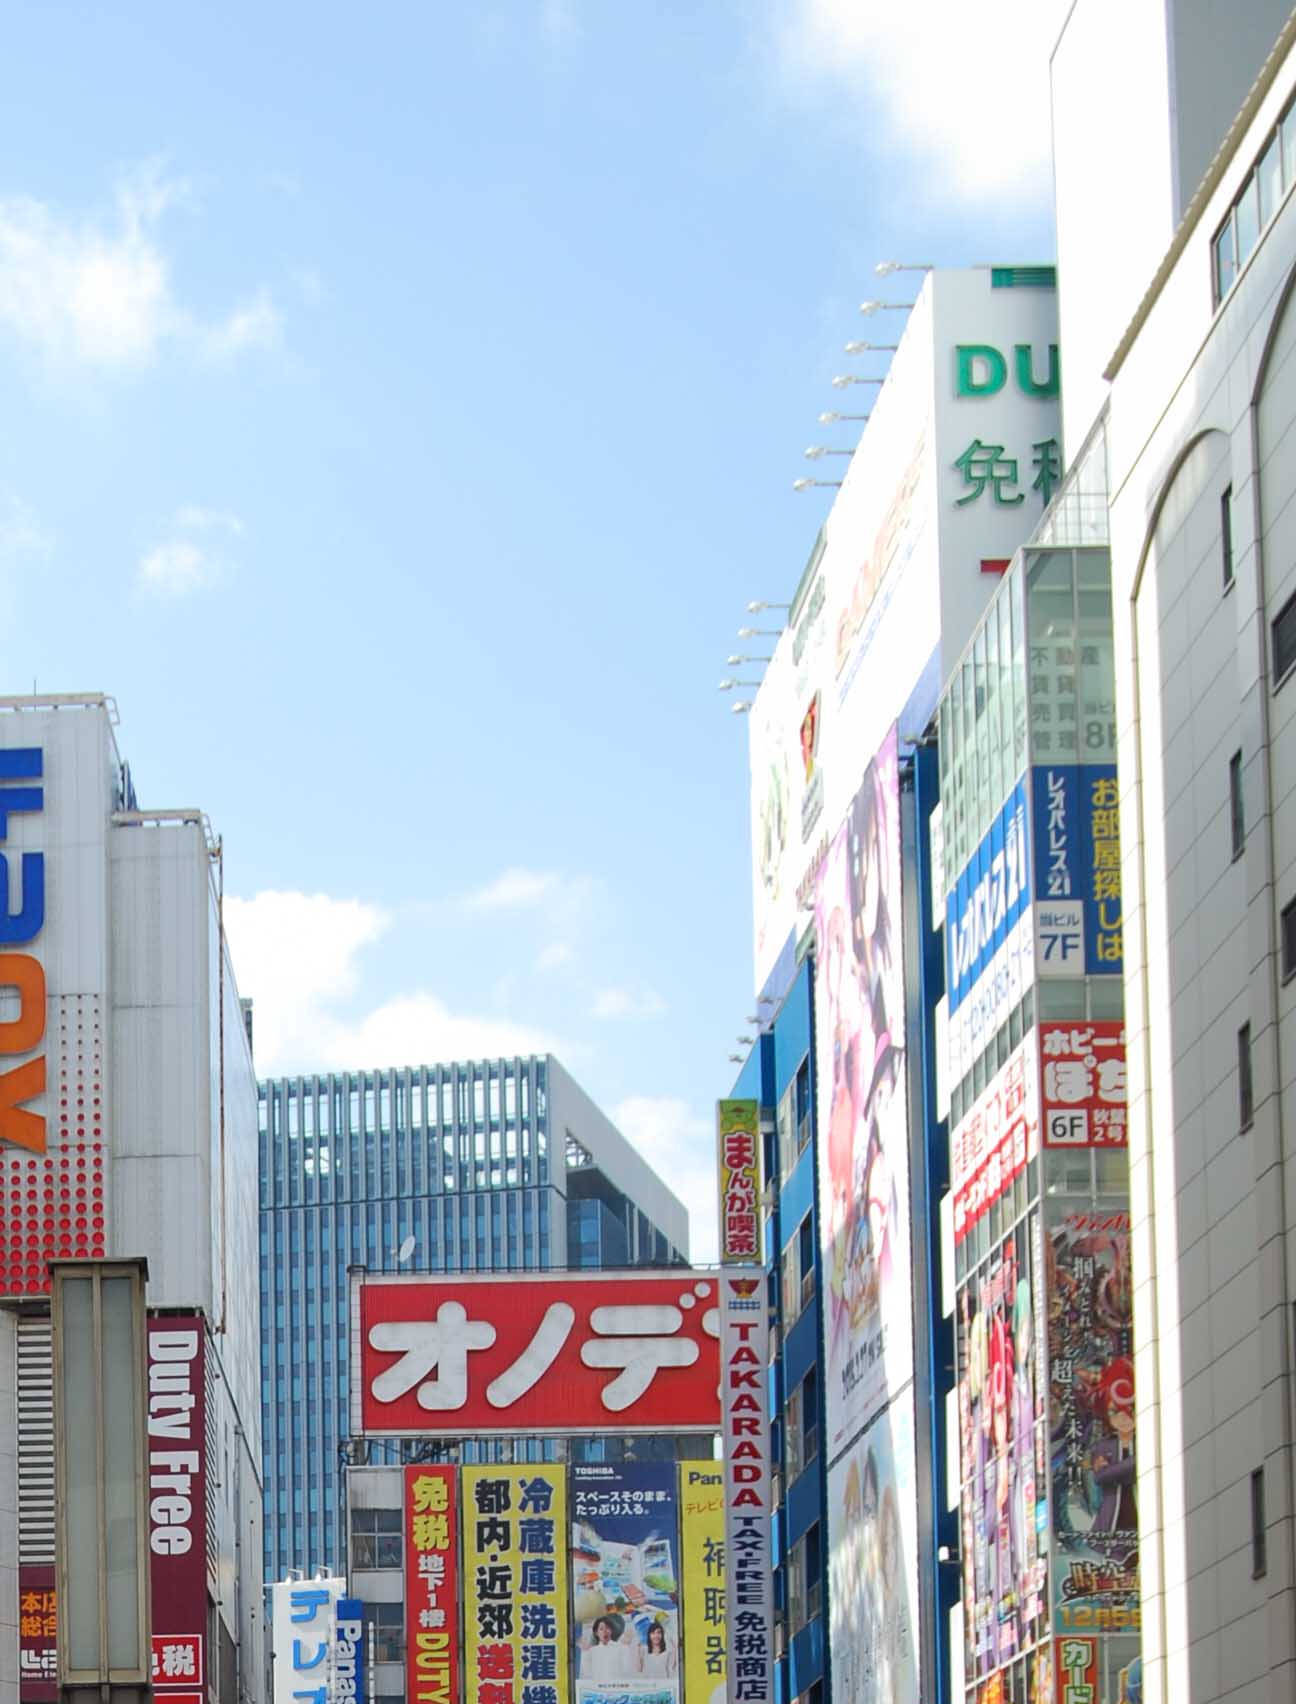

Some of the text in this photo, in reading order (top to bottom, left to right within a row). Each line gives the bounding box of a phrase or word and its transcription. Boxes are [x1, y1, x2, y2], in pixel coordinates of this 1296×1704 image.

[1045, 769, 1072, 896] レオパレス21
[1039, 933, 1081, 961] 7F
[1051, 1115, 1084, 1139] 6F
[723, 1131, 756, 1256] まんが喫茶
[368, 1280, 722, 1413] オノデ
[147, 1329, 200, 1557] Duty Free
[574, 1466, 615, 1476] TOSHIBA
[728, 1323, 764, 1509] TAKARADA
[412, 1474, 450, 1552] 免税
[518, 1475, 556, 1597] 冷蔵庫
